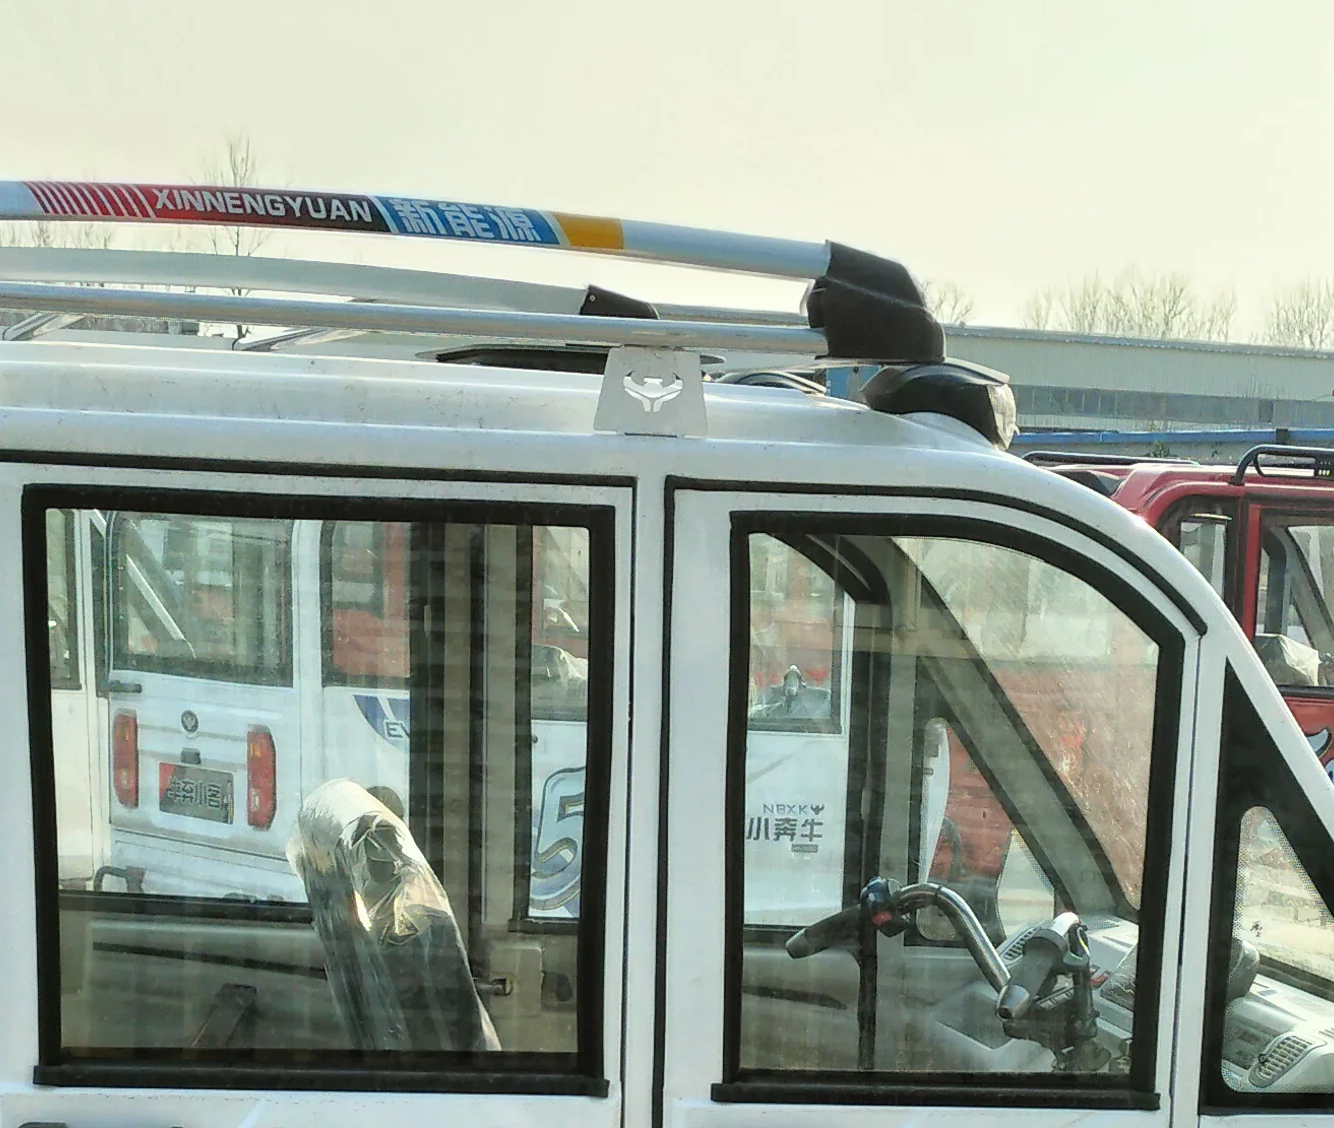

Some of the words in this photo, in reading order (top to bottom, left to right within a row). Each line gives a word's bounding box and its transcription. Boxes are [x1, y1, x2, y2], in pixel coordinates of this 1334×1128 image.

[152, 188, 373, 223] XINNENGYUAN
[388, 199, 542, 242] 新能源
[763, 803, 807, 815] NBXK
